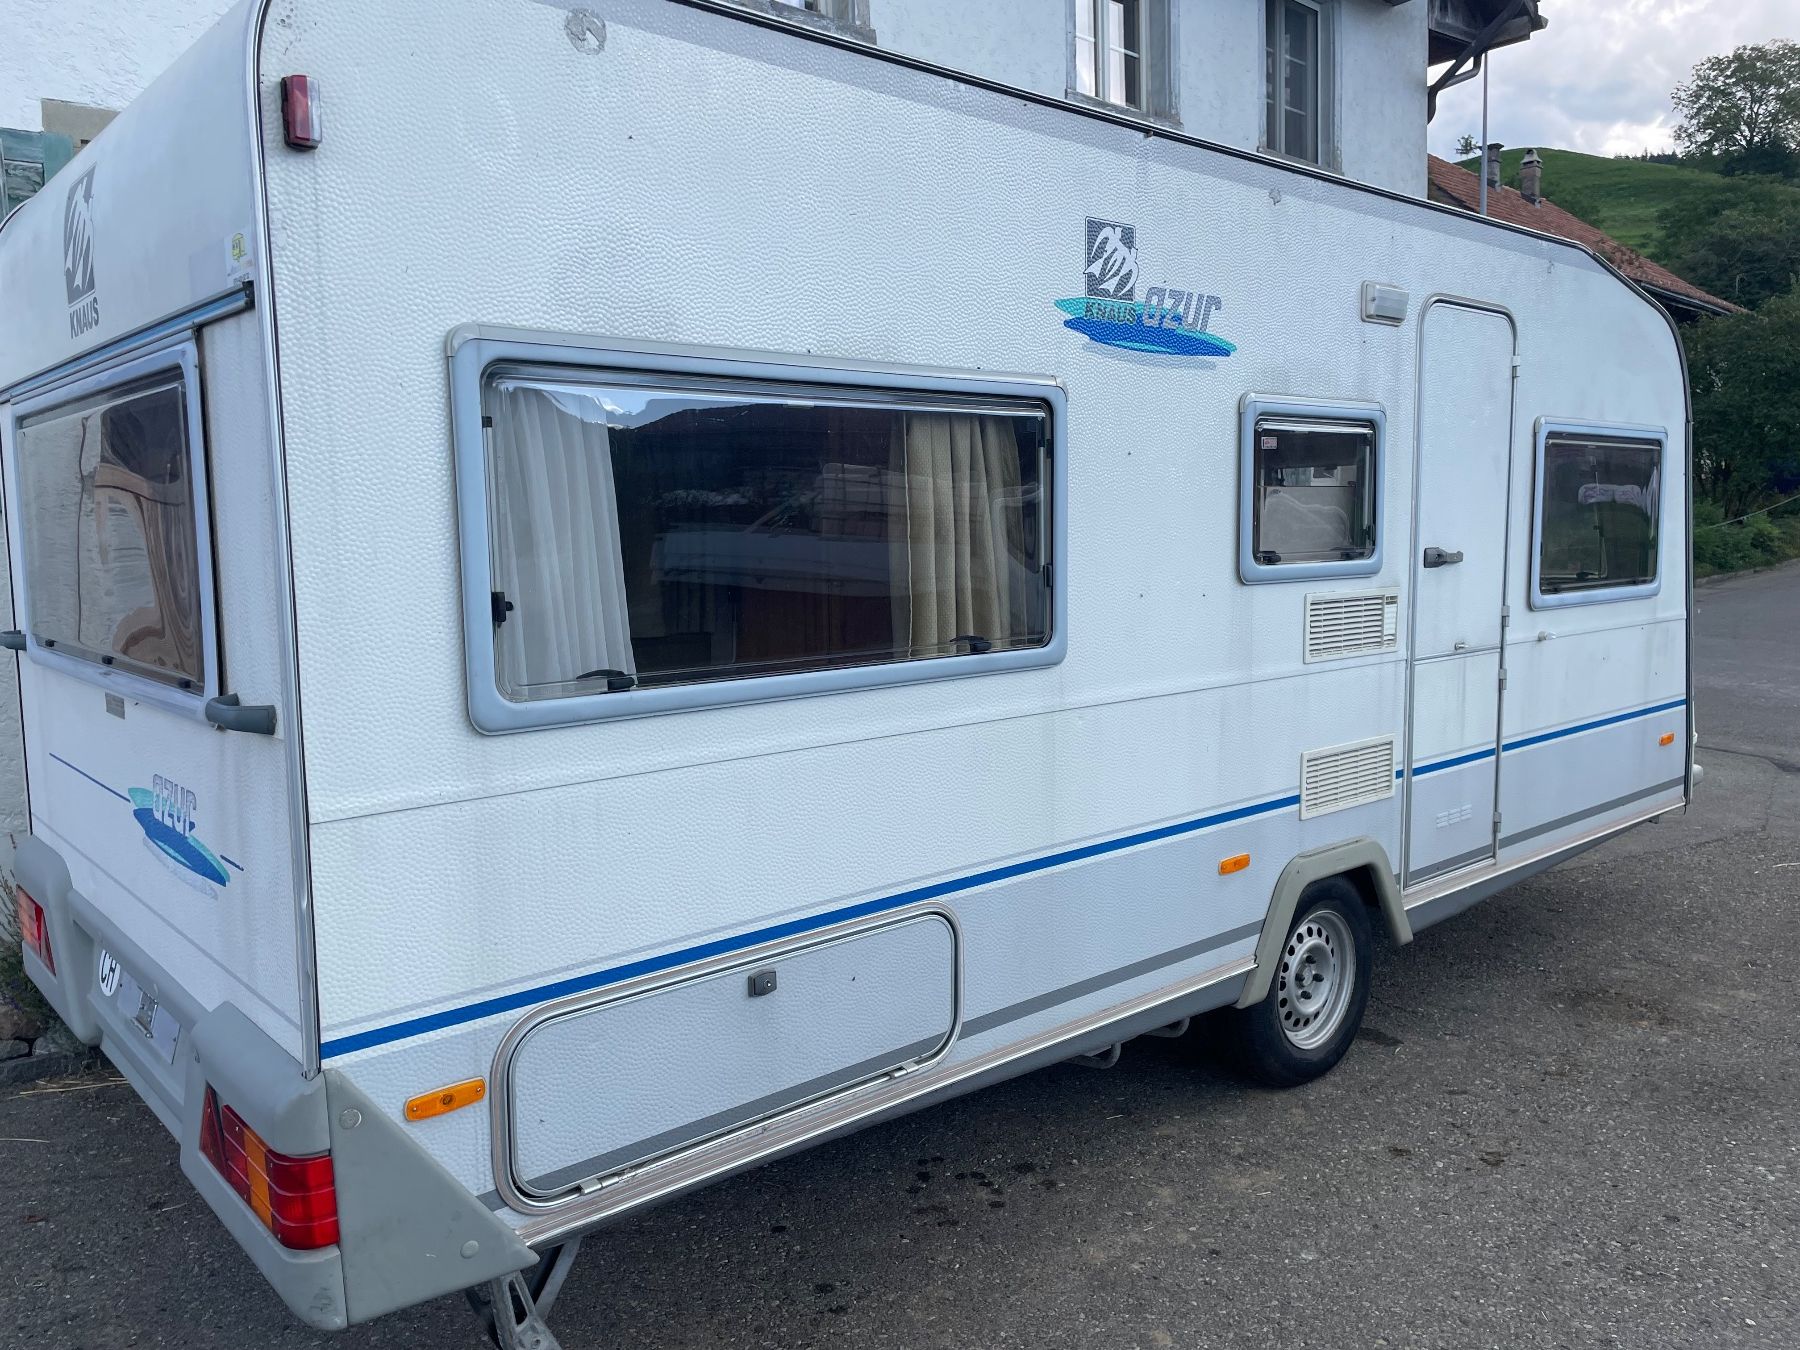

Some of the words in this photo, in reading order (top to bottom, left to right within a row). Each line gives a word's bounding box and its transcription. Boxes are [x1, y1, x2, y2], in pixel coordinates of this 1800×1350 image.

[70, 297, 100, 340] KNAUS
[1084, 301, 1137, 325] KNAUS
[1143, 287, 1222, 332] azur
[152, 773, 197, 837] azur
[101, 950, 118, 993] CH
